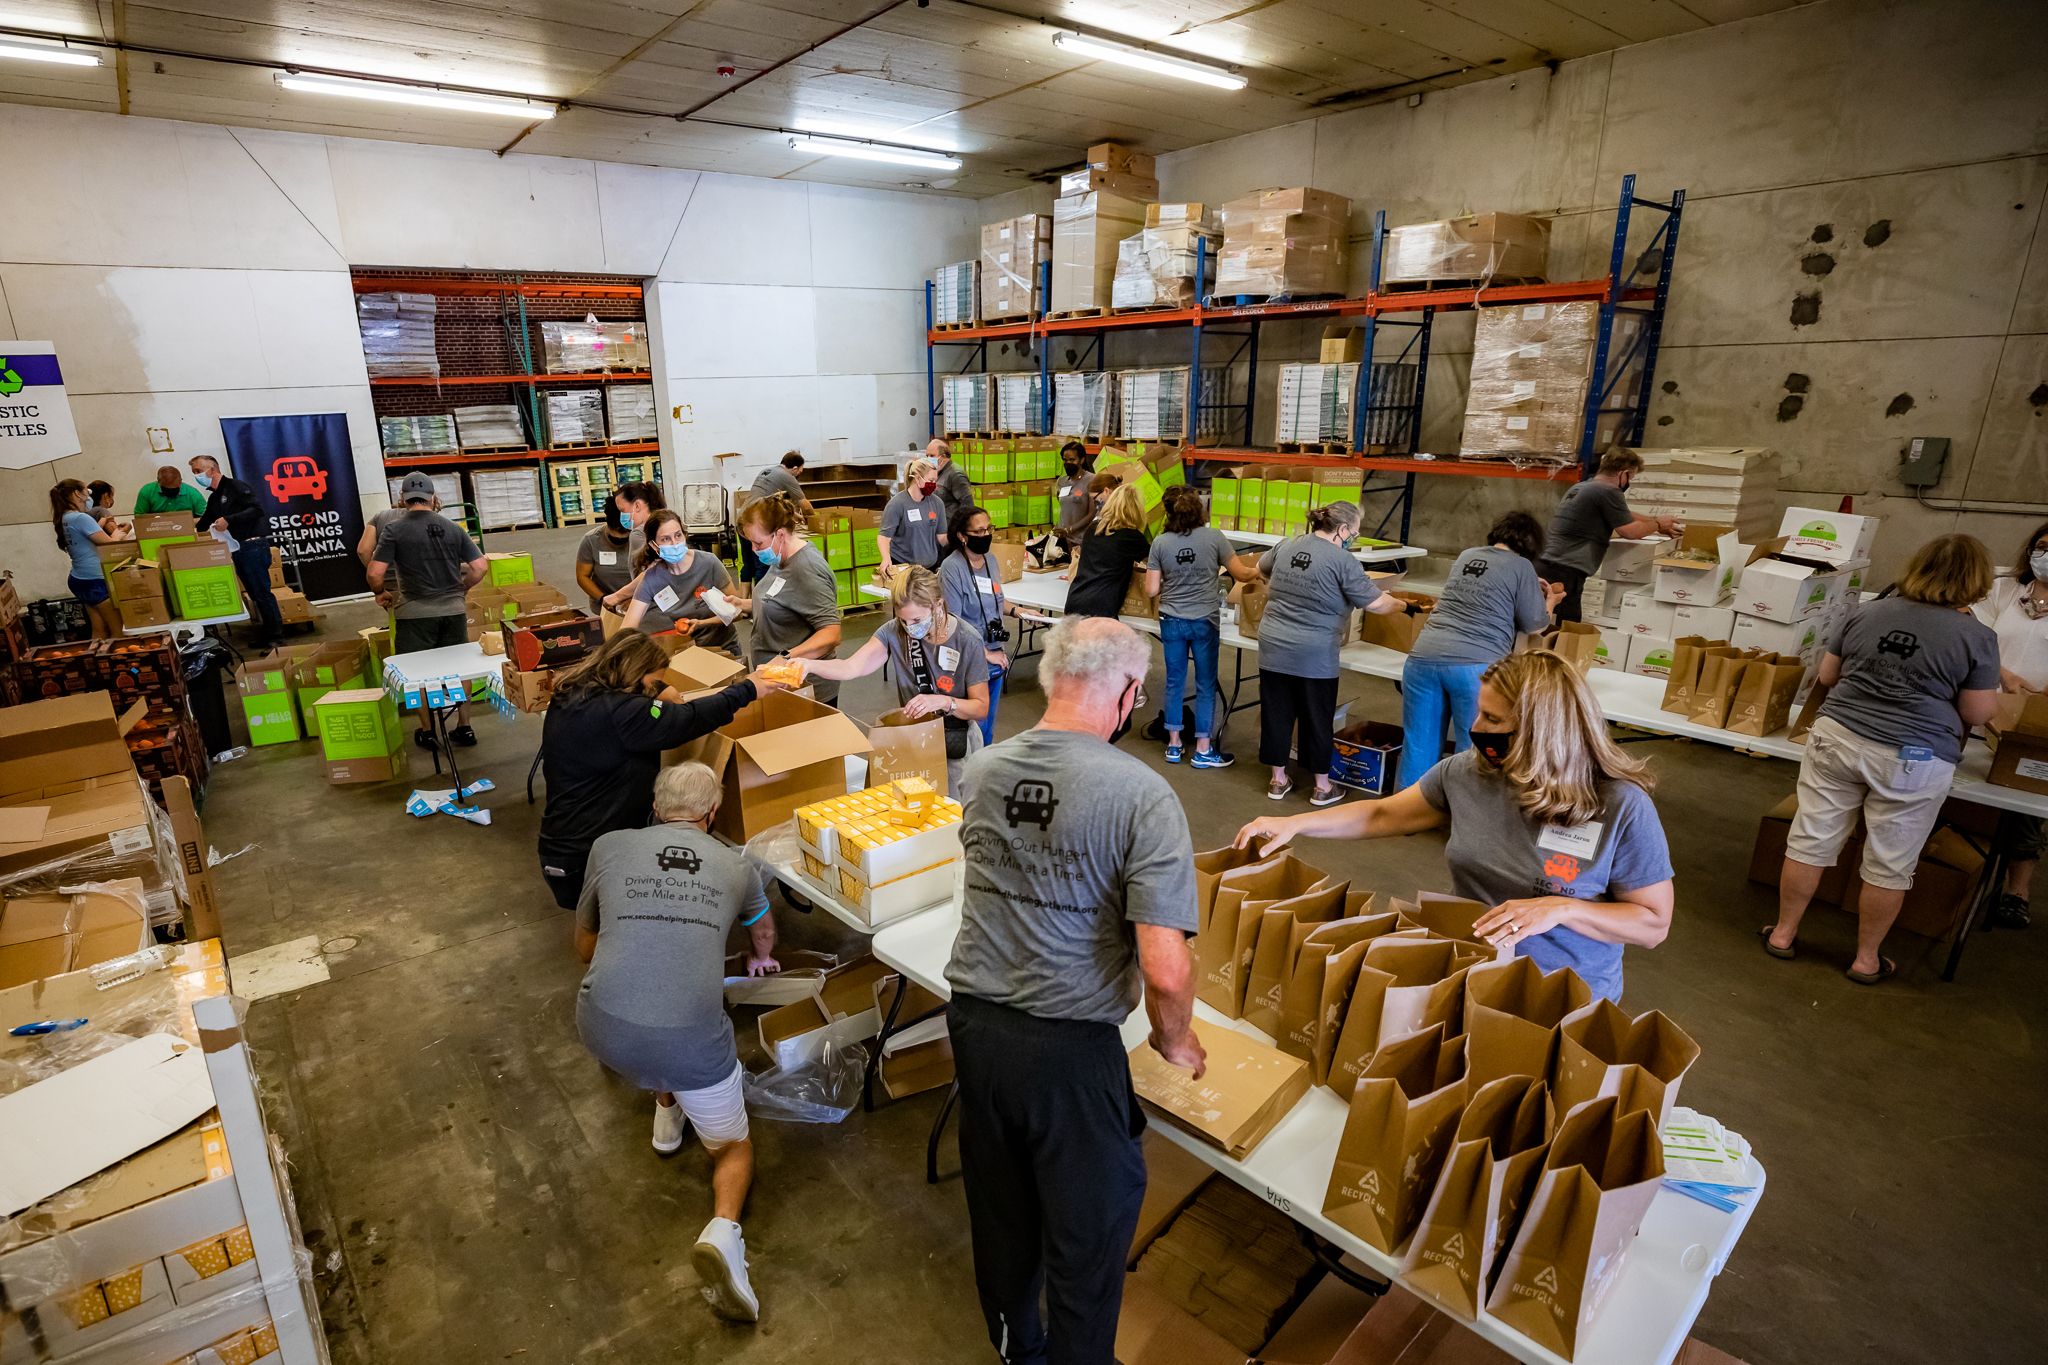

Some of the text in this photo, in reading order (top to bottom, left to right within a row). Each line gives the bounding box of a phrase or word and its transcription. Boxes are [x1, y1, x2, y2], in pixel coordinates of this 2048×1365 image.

[269, 511, 340, 529] SECOND
[272, 525, 343, 543] HELPINGS
[183, 842, 200, 874] ULINE
[1011, 837, 1037, 853] Out
[1041, 841, 1088, 864] Hunger
[974, 850, 995, 866] One
[1025, 863, 1037, 875] at
[1041, 867, 1048, 876] a
[1051, 862, 1084, 882] Time
[625, 876, 724, 897] Driving Out Hunger
[626, 889, 649, 899] One
[652, 888, 675, 900] Mile
[678, 893, 689, 901] at
[700, 893, 719, 909] Time
[1199, 1087, 1222, 1103] ME
[1341, 1186, 1387, 1217] RECYCLE ME
[1423, 1250, 1460, 1270] RECYCLE
[1512, 1282, 1565, 1319] RECYCLE ME
